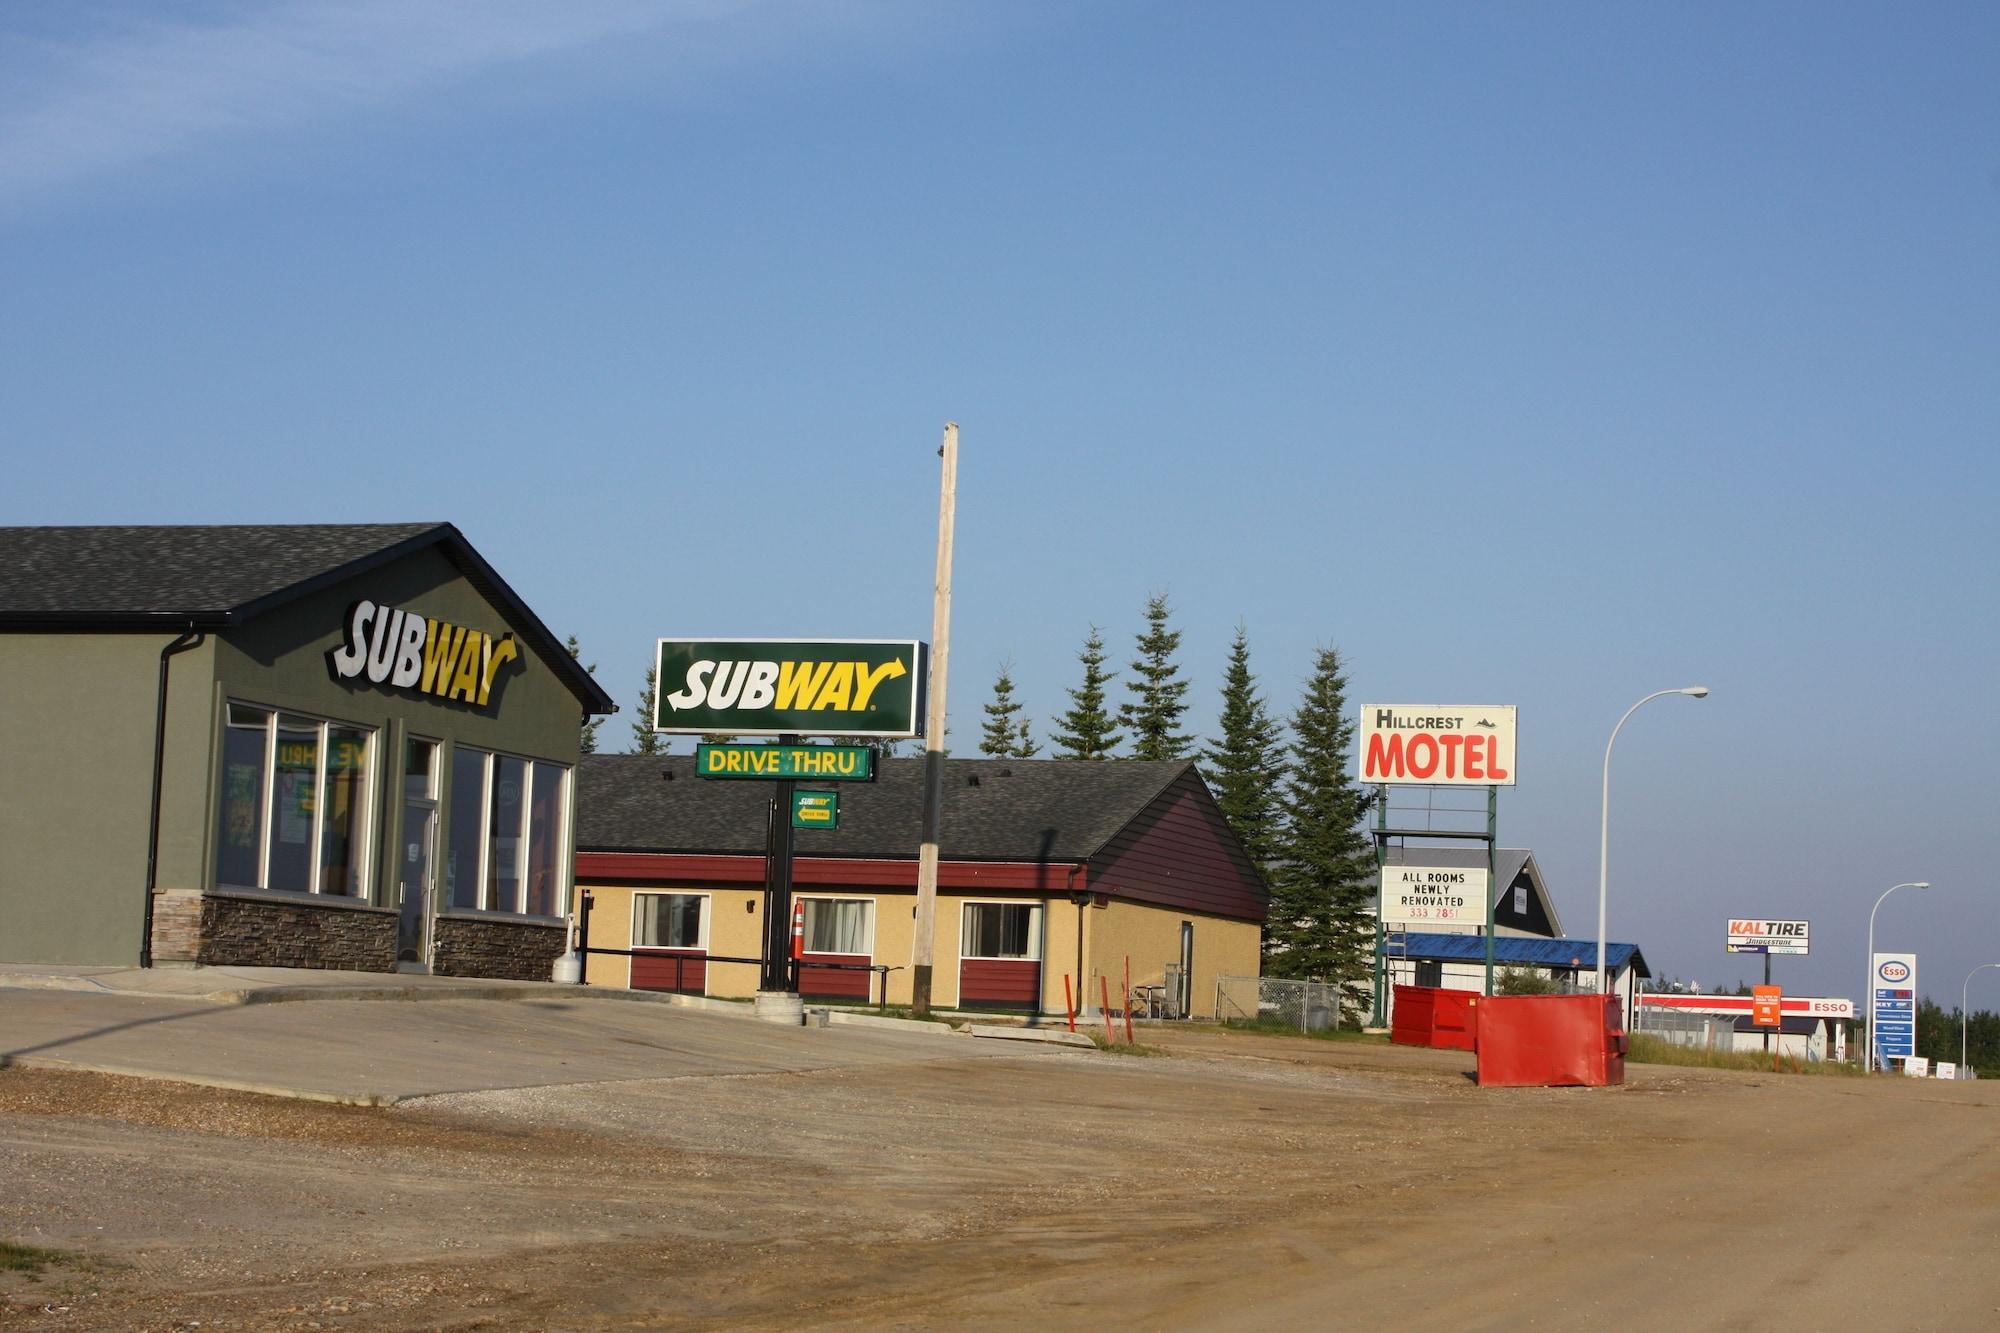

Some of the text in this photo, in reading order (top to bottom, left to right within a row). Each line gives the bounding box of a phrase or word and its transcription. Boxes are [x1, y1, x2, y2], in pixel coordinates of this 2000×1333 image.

[332, 600, 518, 706] SUBWAY
[667, 656, 907, 712] SUBWAY
[708, 750, 856, 773] DRIVE THRU
[1365, 733, 1508, 780] MOTEL
[798, 797, 831, 806] SUBWAY
[1402, 872, 1465, 883] ALL ROOMS
[1414, 884, 1450, 894] NEWLY
[1401, 896, 1464, 906] RENOVATED
[1409, 908, 1428, 918] 333
[1730, 921, 1806, 936] KAL TIRE
[1814, 1003, 1848, 1013] ESSO
